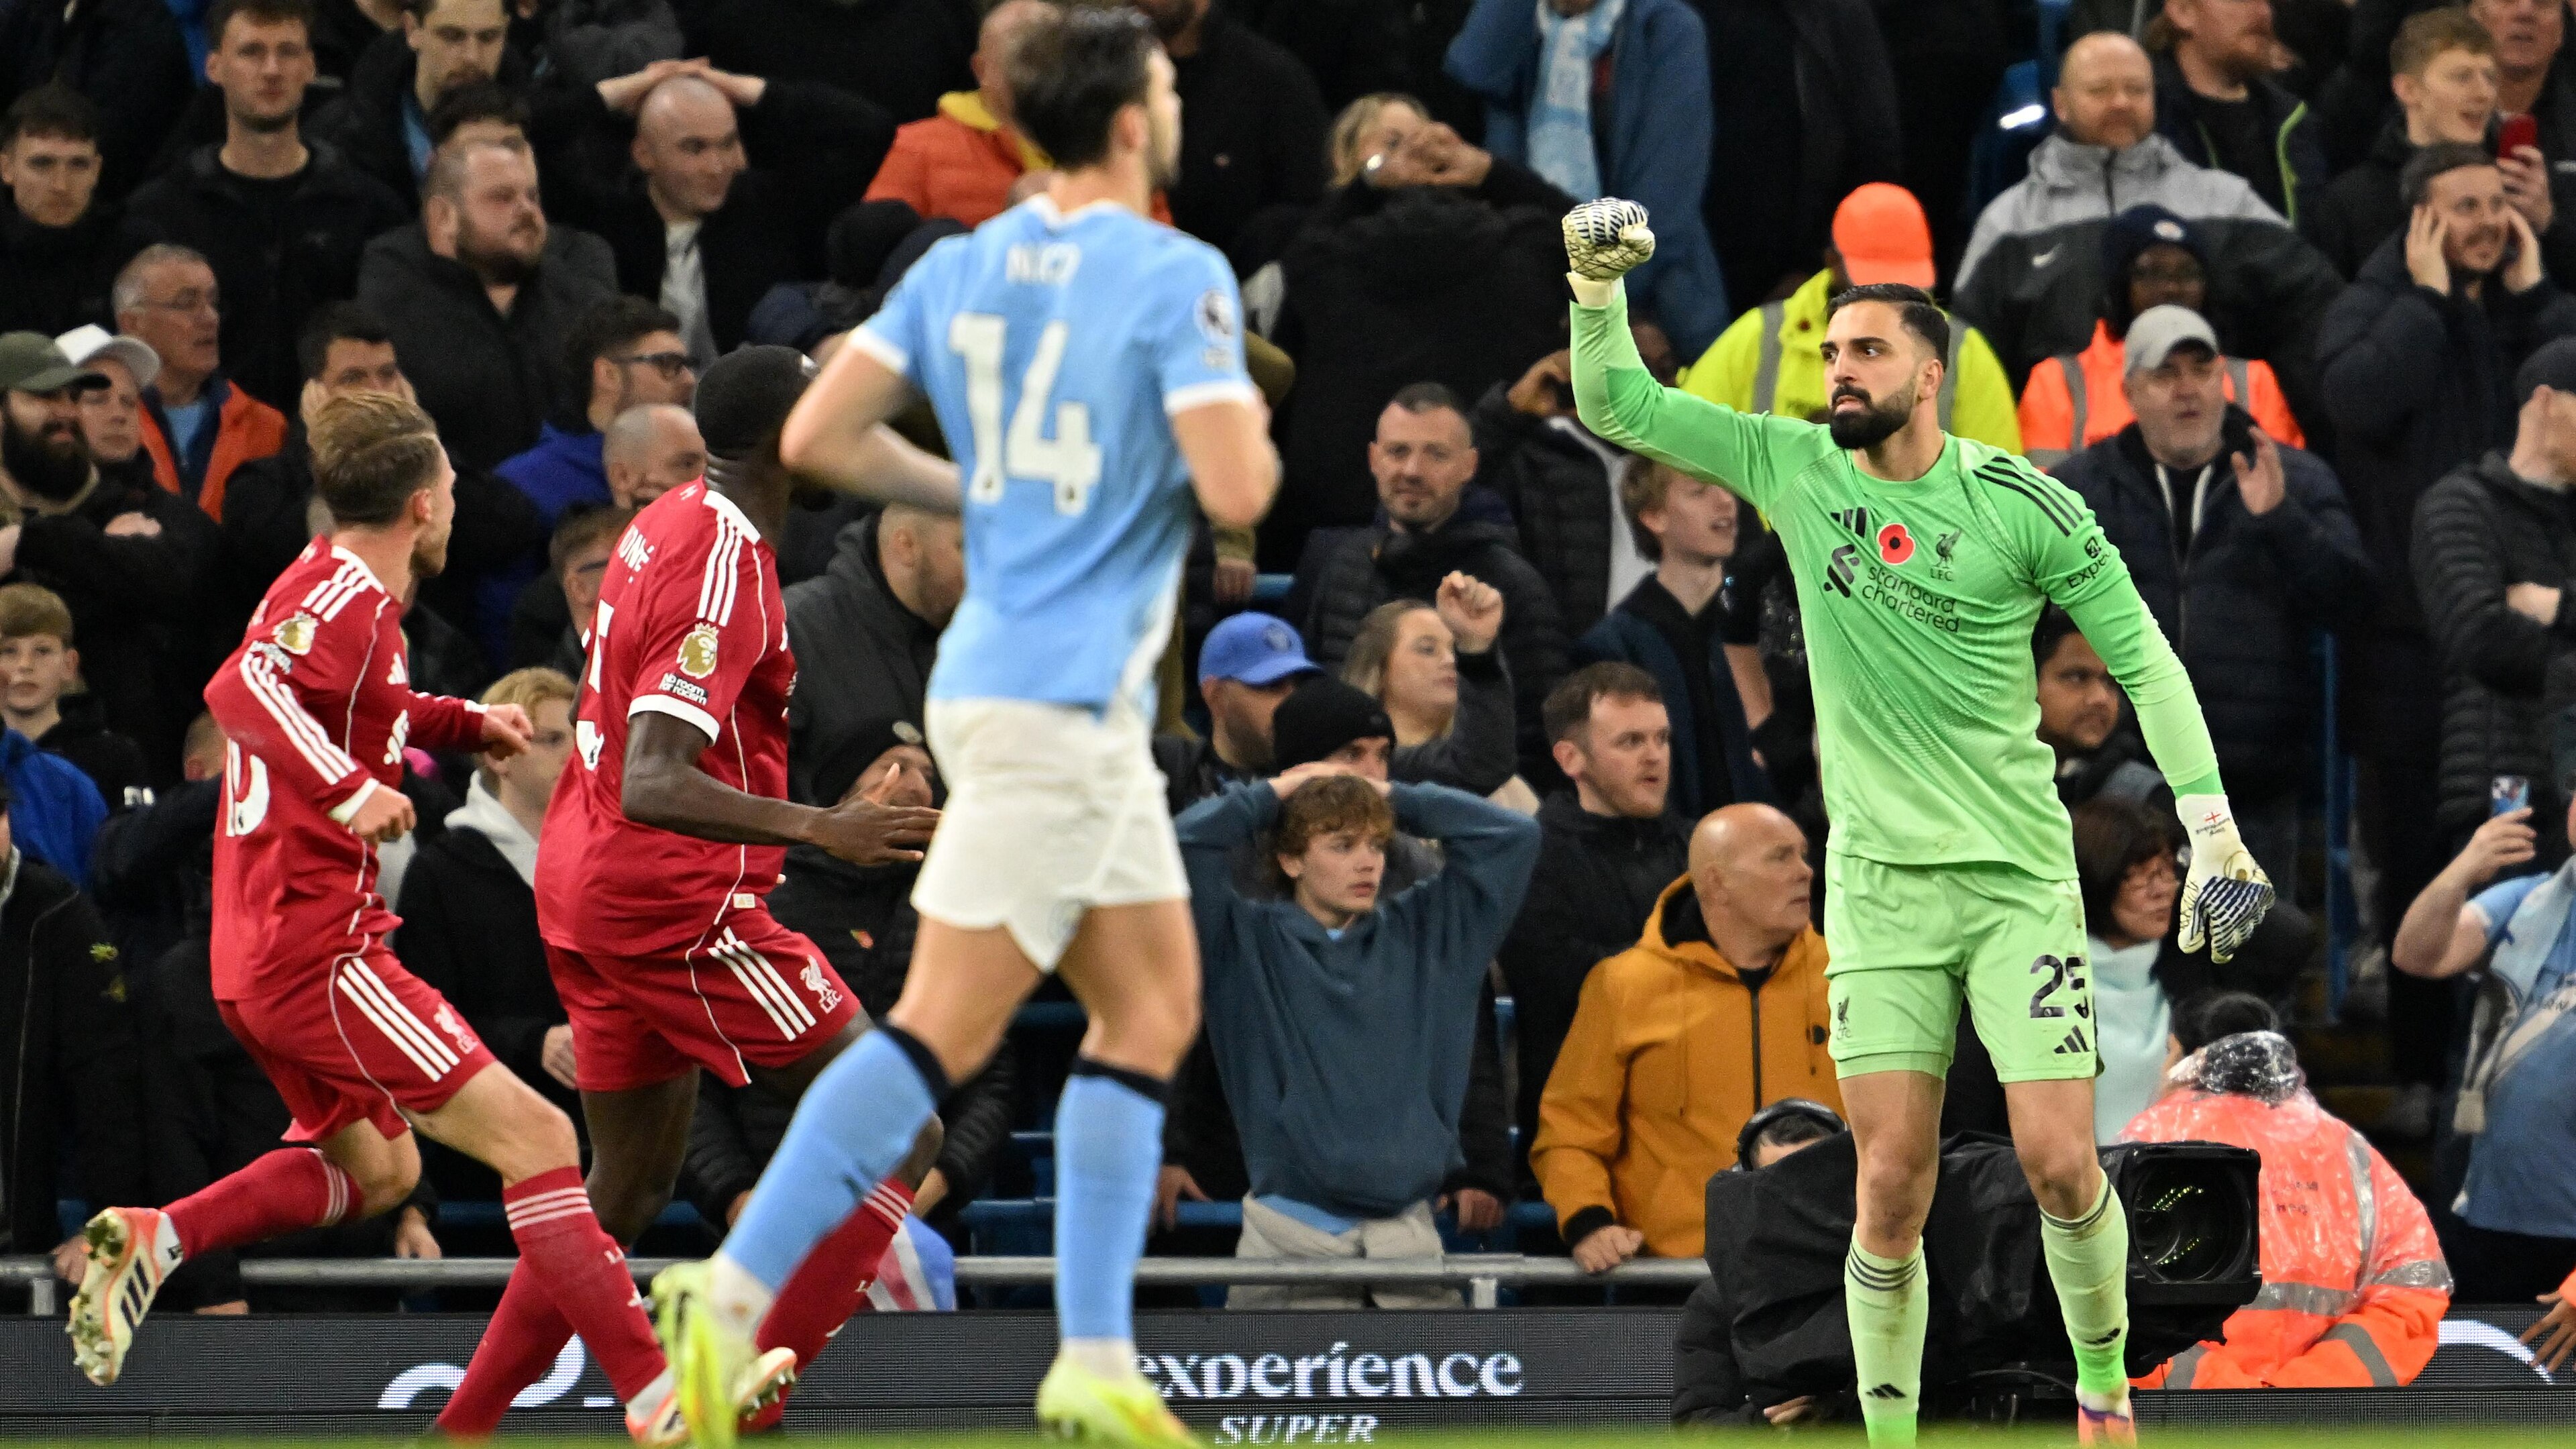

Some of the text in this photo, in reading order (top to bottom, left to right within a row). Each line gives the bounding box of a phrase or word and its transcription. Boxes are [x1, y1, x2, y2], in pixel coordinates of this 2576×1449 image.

[949, 311, 1103, 515] 14
[1862, 585, 1960, 633] chartered
[676, 678, 704, 696] room
[2030, 955, 2088, 1018] 25
[1215, 1415, 1379, 1446] SUPER
